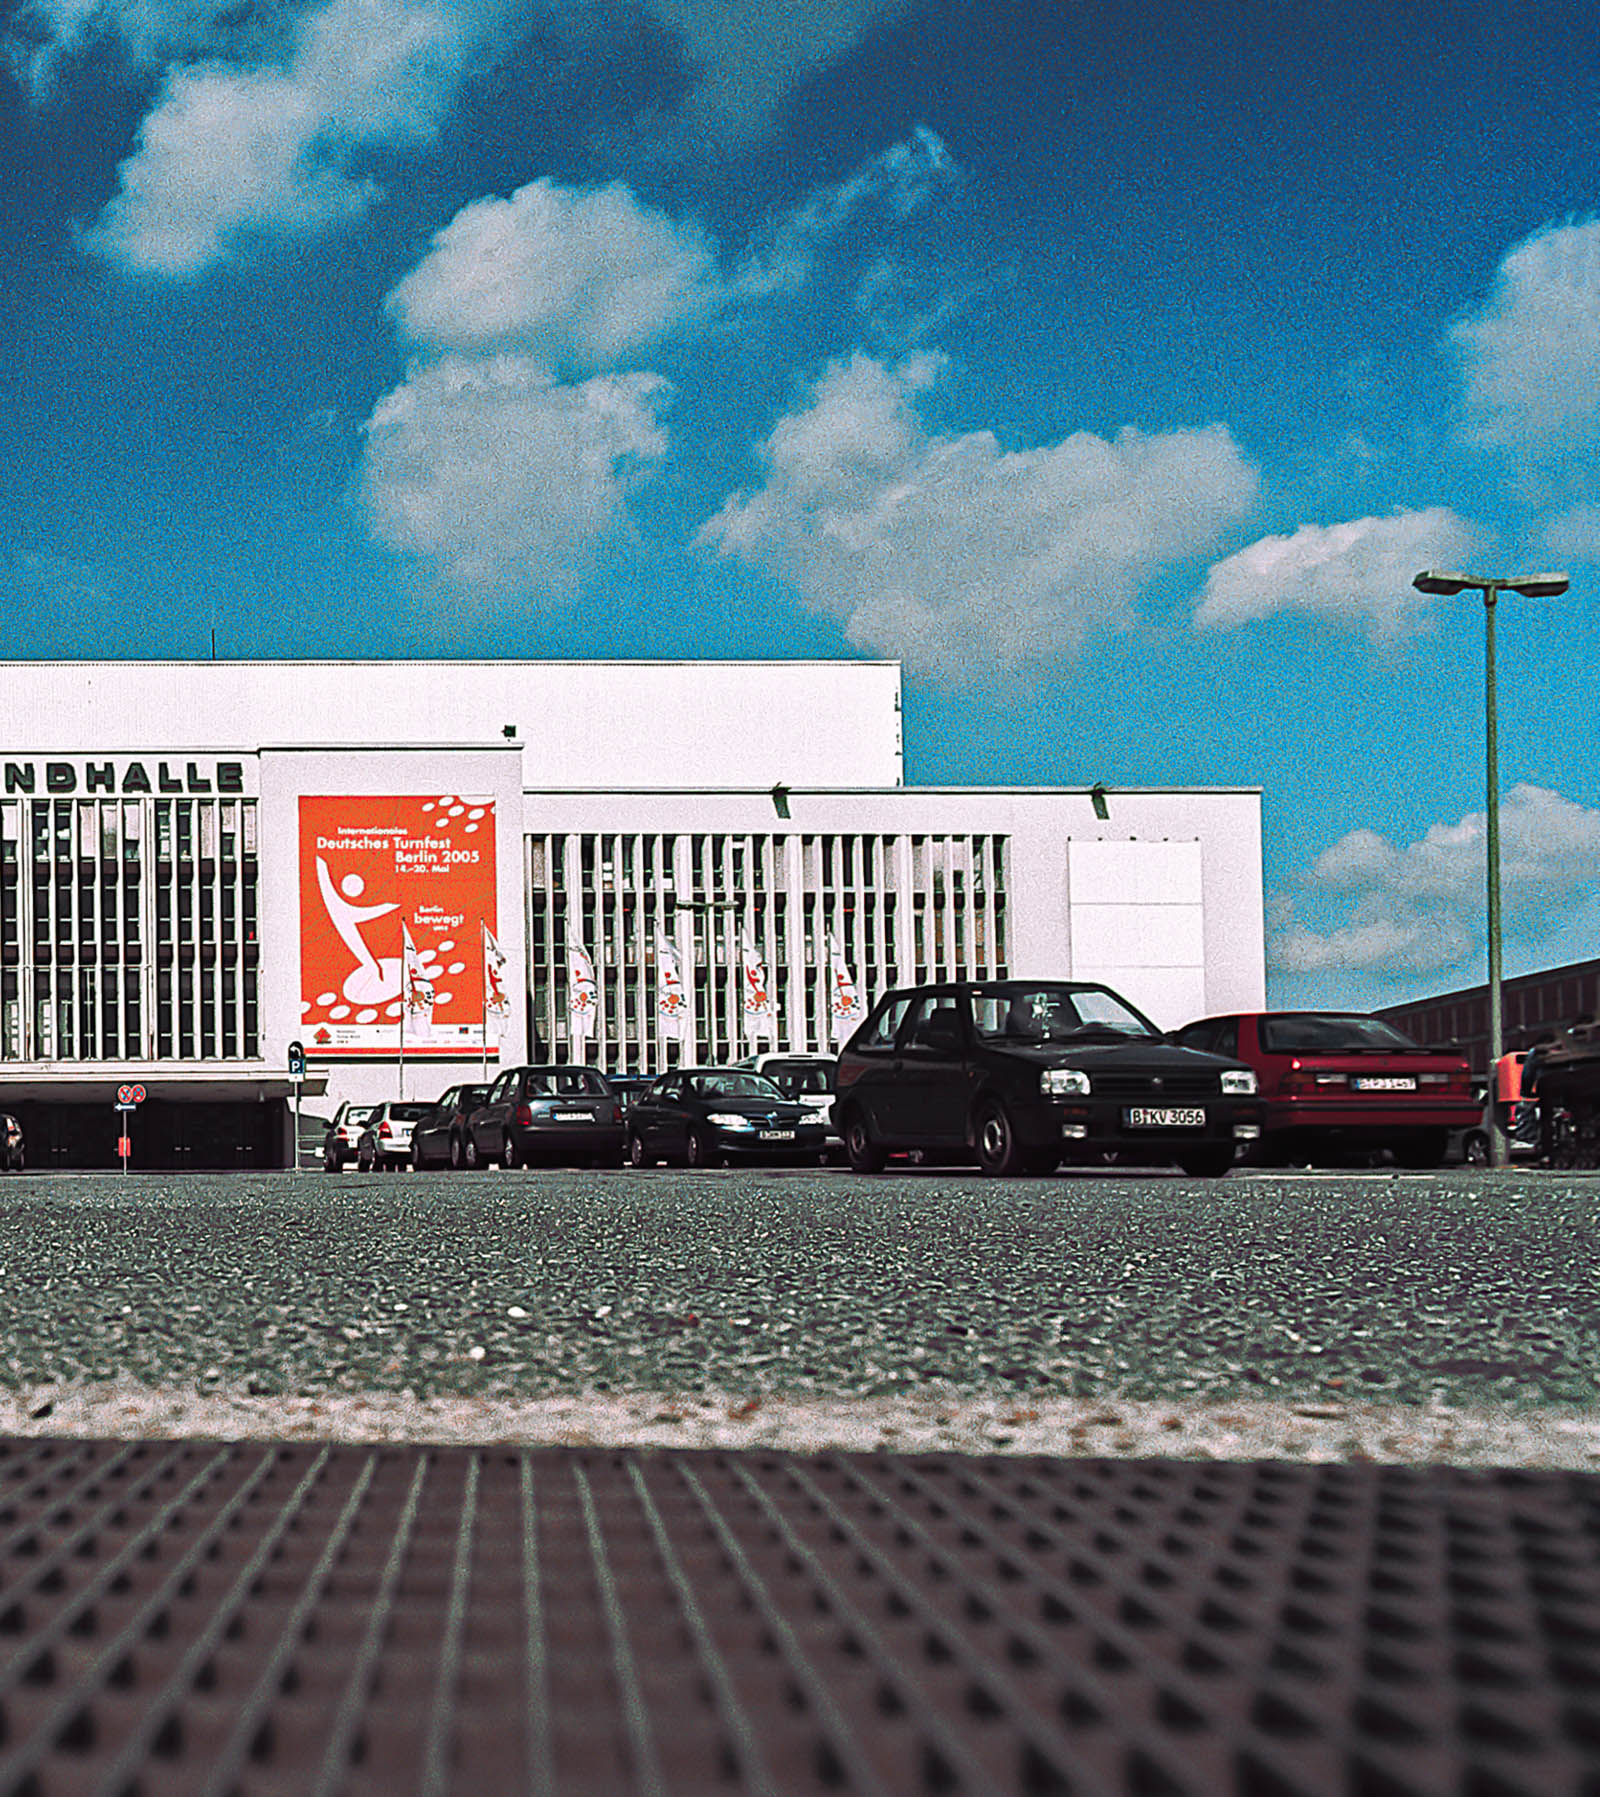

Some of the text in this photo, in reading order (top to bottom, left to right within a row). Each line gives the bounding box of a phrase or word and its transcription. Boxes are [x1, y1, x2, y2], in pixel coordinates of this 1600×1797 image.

[337, 826, 408, 835] Internationales
[316, 835, 452, 849] Deutsches Turnfest
[395, 850, 480, 863] Berlin 2005
[432, 864, 450, 873] Mai
[414, 911, 464, 927] bewegt
[291, 1060, 300, 1073] P
[1169, 1109, 1204, 1124] 3056
